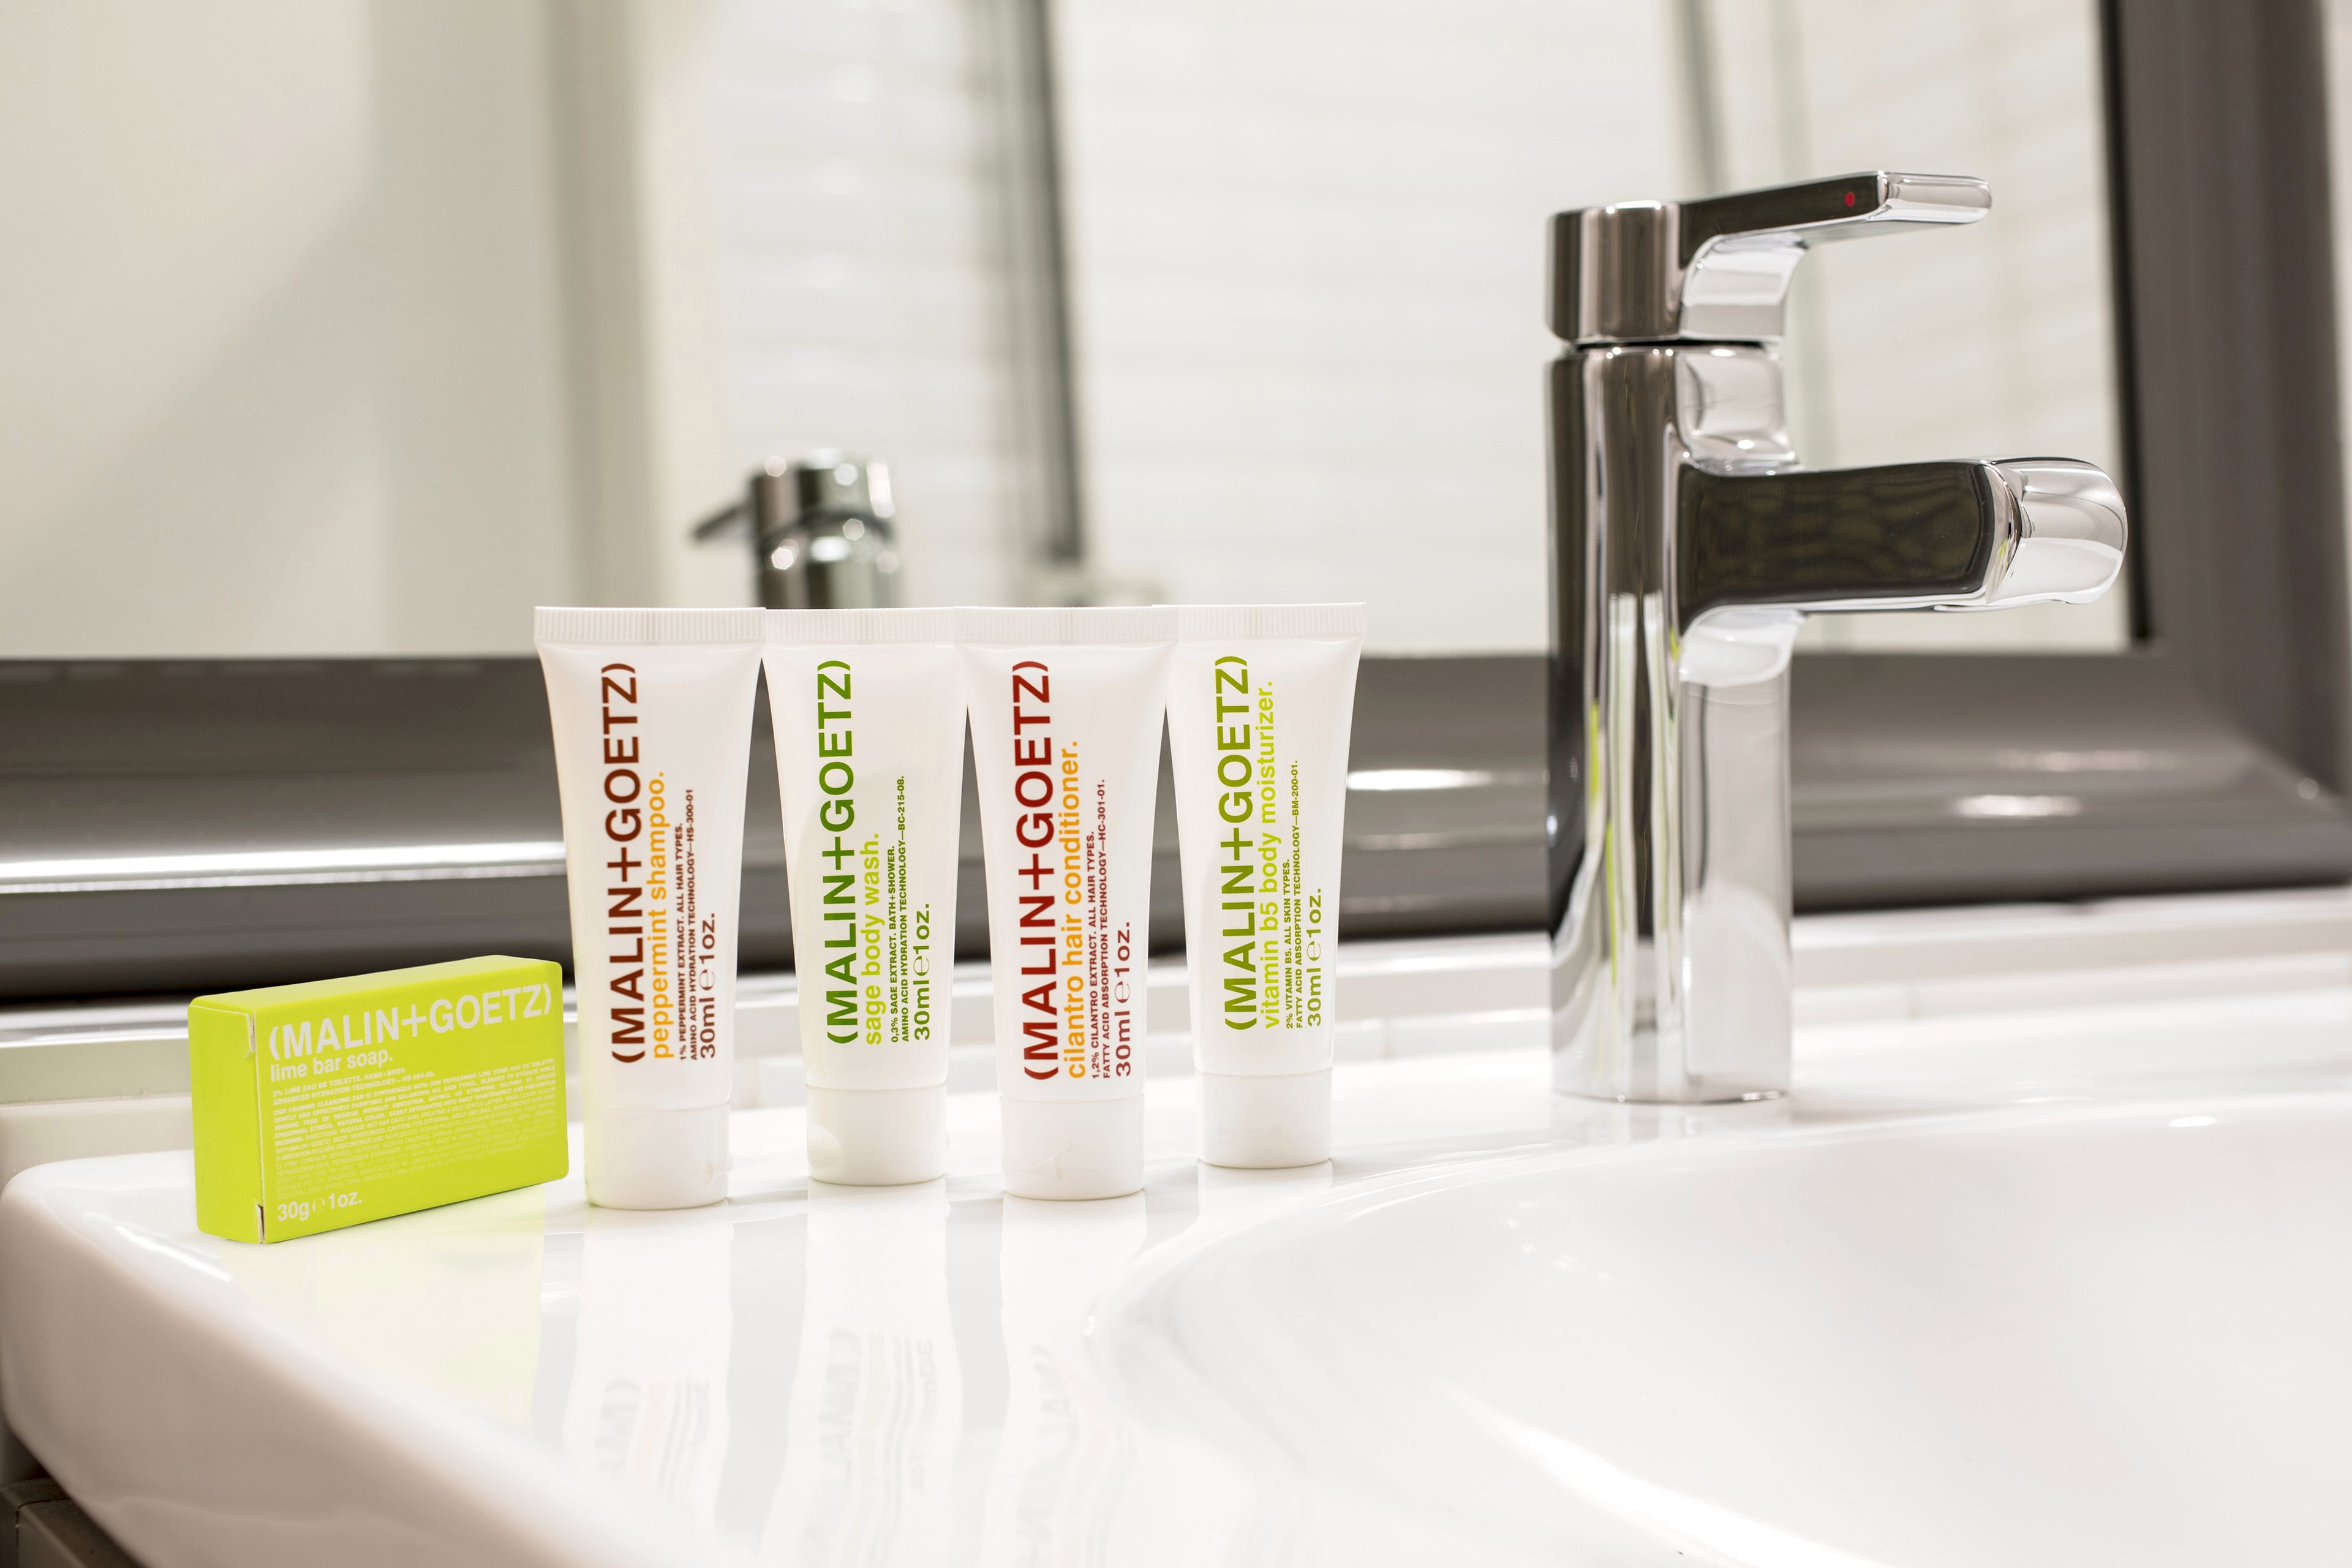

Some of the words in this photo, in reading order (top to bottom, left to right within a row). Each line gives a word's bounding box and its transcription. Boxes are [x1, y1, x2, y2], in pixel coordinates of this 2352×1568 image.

[1255, 682, 1276, 824] moisturizer.
[647, 772, 670, 900] shampoo.
[674, 823, 683, 861] TYPES.
[817, 660, 858, 1044] (MALIN+GOETZ)
[1058, 742, 1082, 905] conditioner.
[1086, 832, 1095, 872] TYPES.
[1215, 656, 1257, 1030] (MALIN+GOETZ)
[601, 663, 646, 1063] (MALIN+GOETZ)
[859, 834, 880, 906] wash.
[1012, 661, 1058, 1080] (MALIN+GOETZ)
[1087, 875, 1096, 903] HAIR
[1257, 832, 1281, 892] body
[1282, 859, 1291, 895] TYPES.
[677, 916, 685, 968] EXTRACT.
[860, 914, 884, 976] body
[1060, 914, 1083, 965] hair
[1088, 907, 1096, 927] ALL
[1259, 902, 1278, 931] b5
[648, 909, 674, 1058] peppermint
[889, 933, 897, 983] EXTRACT.
[1088, 931, 1098, 987] EXTRACT.
[1100, 934, 1109, 1008] ABSORPTION
[1259, 940, 1280, 1029] vitamin
[270, 983, 552, 1061] (MALIN+GOETZ)
[677, 971, 687, 1042] PEPPERMINT
[865, 985, 886, 1045] sage
[1063, 976, 1086, 1078] cilantro
[1090, 990, 1099, 1049] CILANTRO
[1286, 1013, 1293, 1029] 2%
[270, 1063, 308, 1083] lime
[313, 1056, 341, 1076] bar
[347, 1049, 393, 1069] soap.
[680, 1045, 687, 1060] 1%
[277, 1201, 309, 1221] 30g
[328, 1191, 363, 1210] 1oz.
